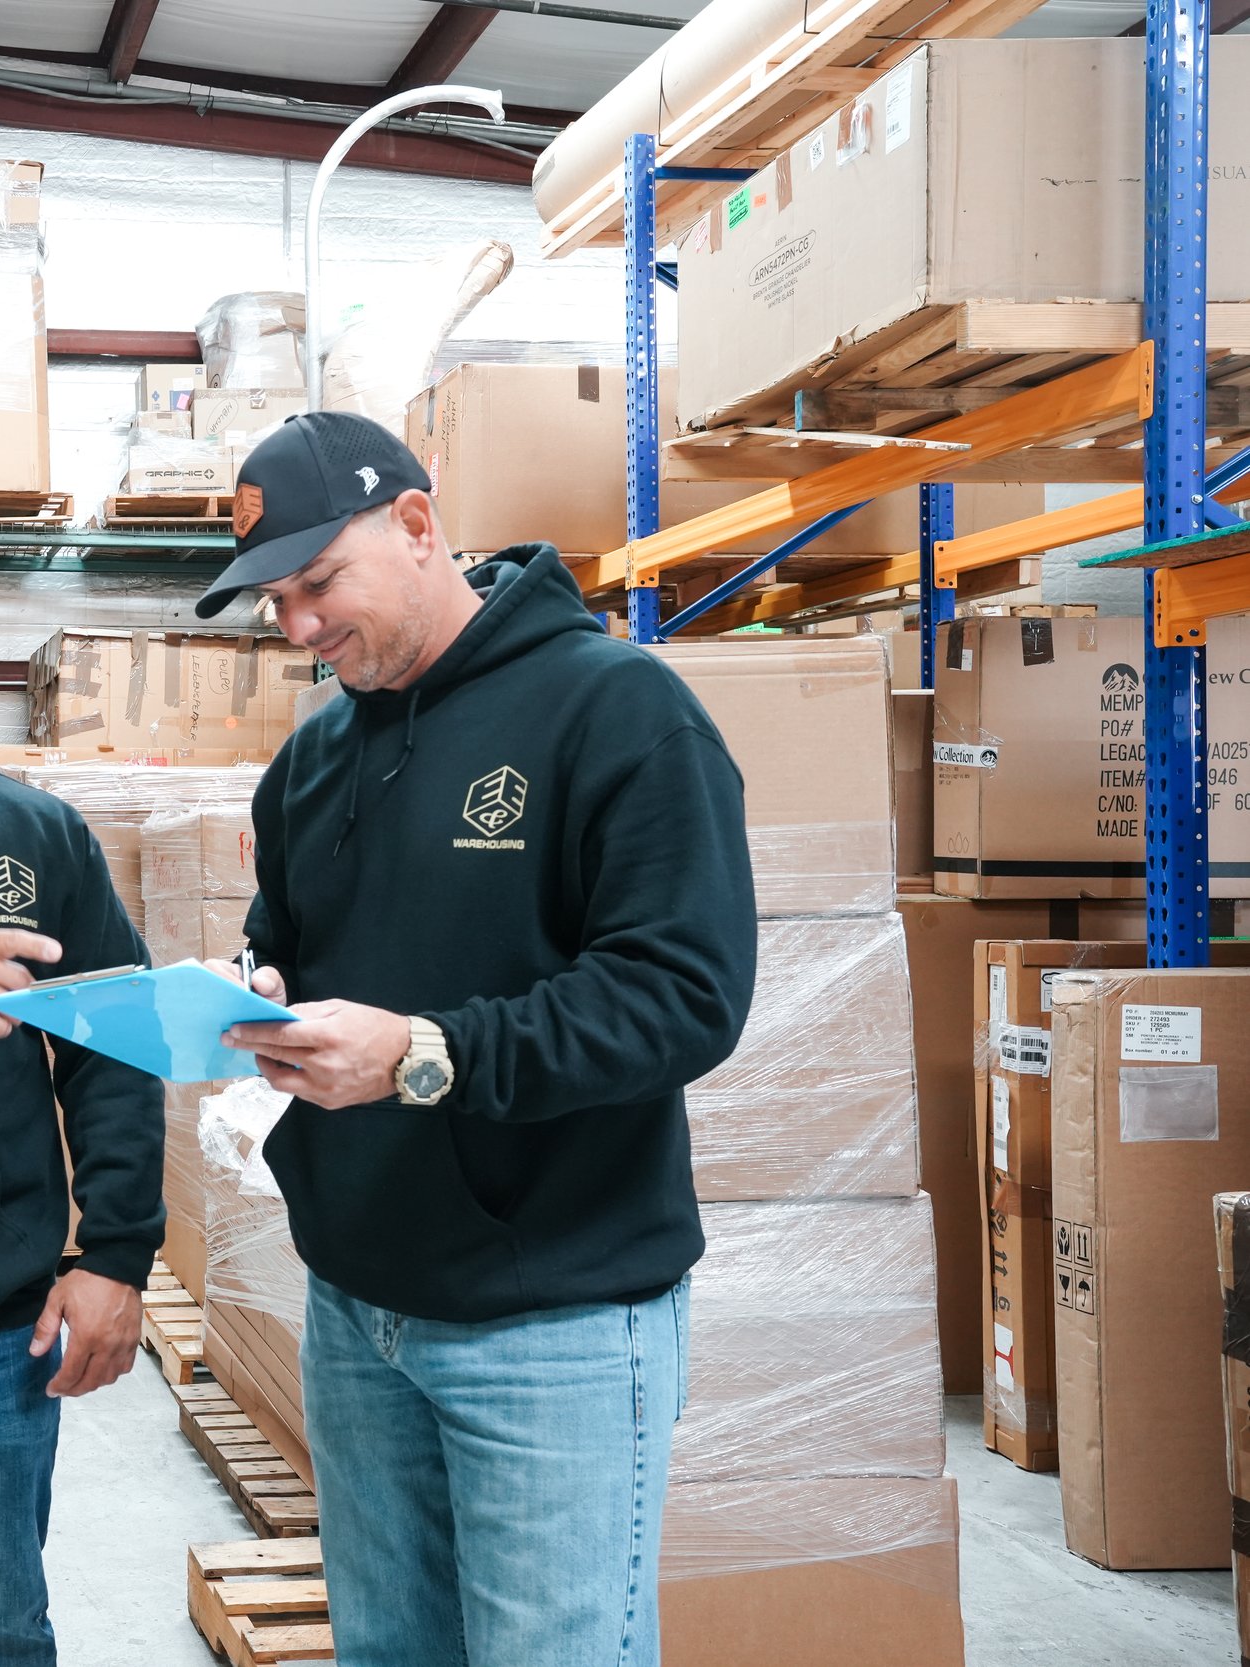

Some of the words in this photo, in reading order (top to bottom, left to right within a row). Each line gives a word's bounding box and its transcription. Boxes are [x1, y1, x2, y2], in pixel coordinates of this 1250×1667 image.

[939, 746, 974, 764] Collection
[1097, 819, 1138, 837] MADE
[453, 838, 525, 850] WAREHOUSING
